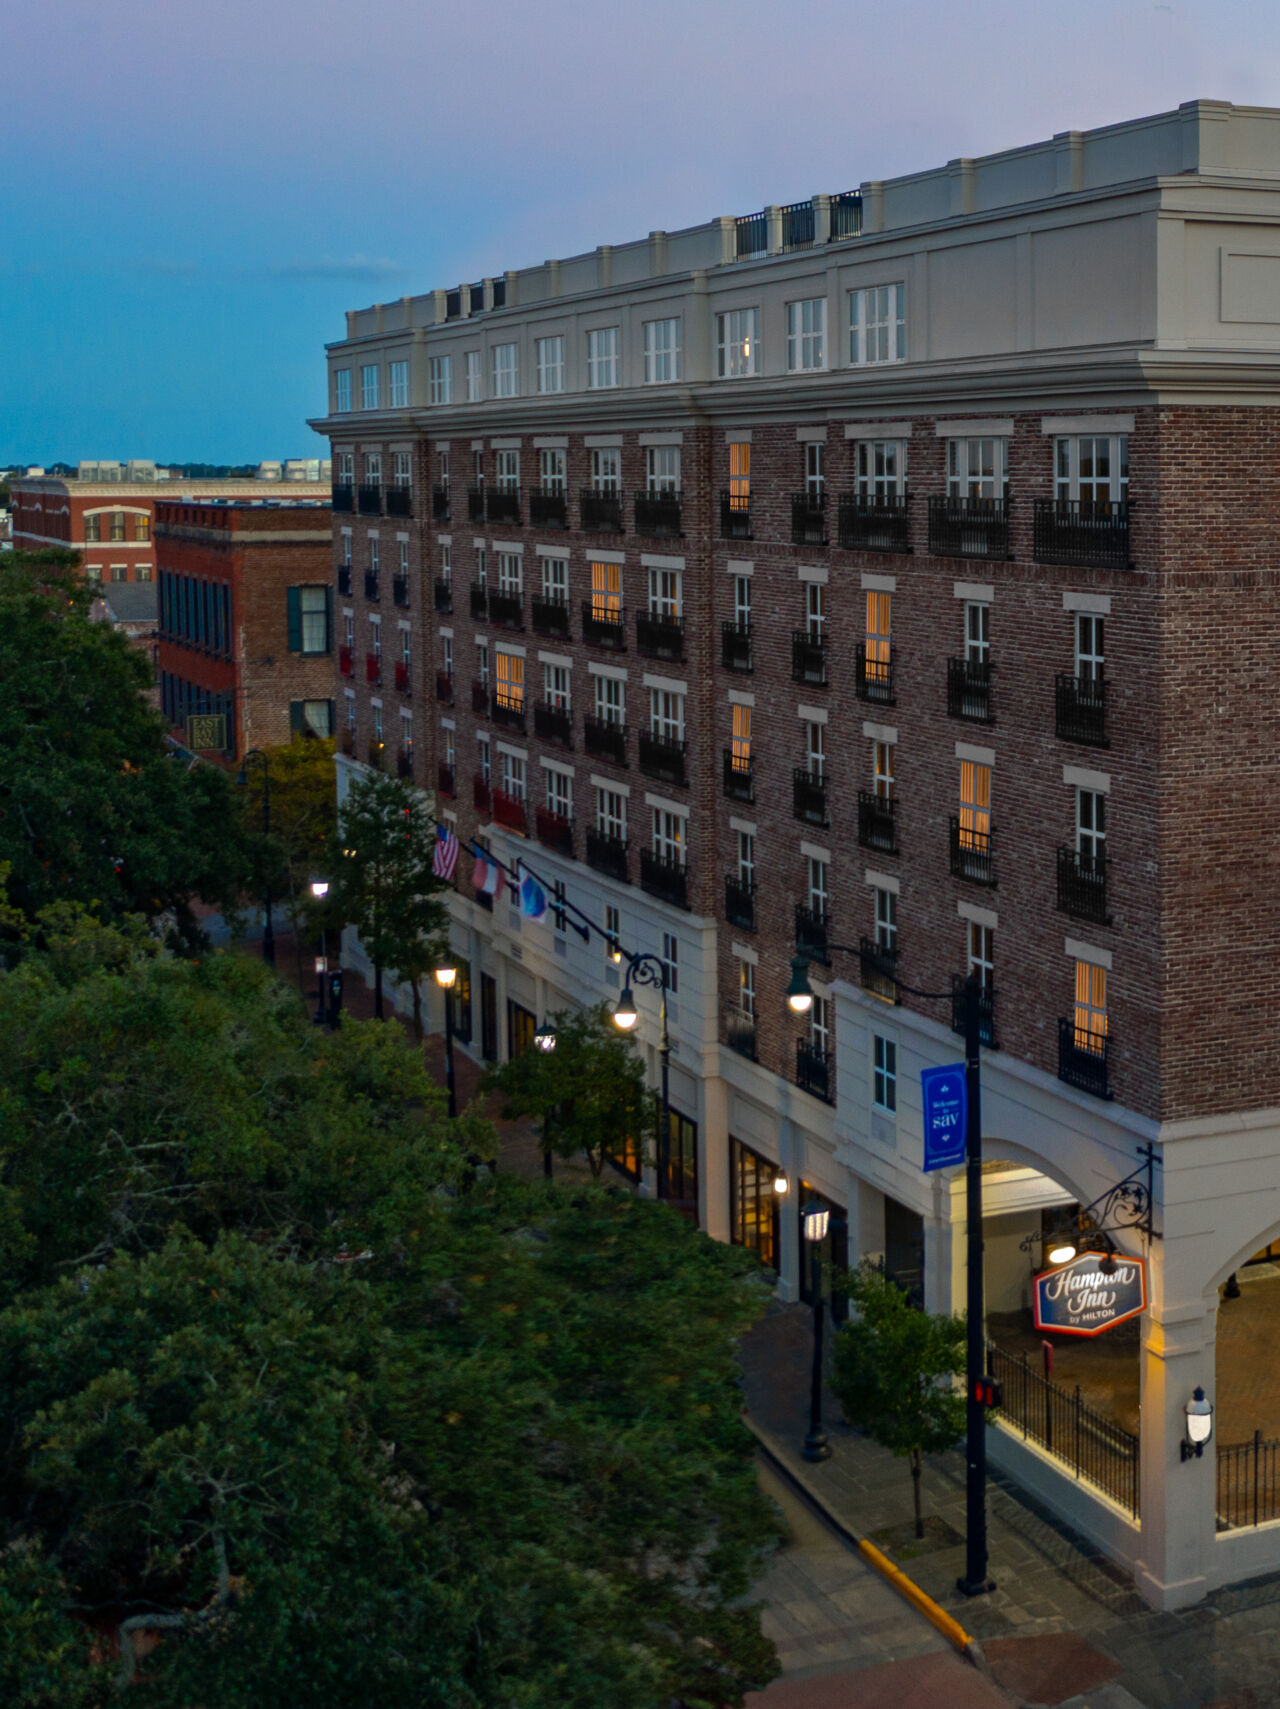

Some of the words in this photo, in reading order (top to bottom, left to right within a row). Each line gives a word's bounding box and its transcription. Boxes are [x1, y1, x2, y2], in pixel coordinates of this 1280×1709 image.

[193, 718, 218, 728] EAST
[932, 1112, 960, 1128] sav
[1067, 1288, 1116, 1314] Inn
[1082, 1308, 1115, 1320] HILTON
